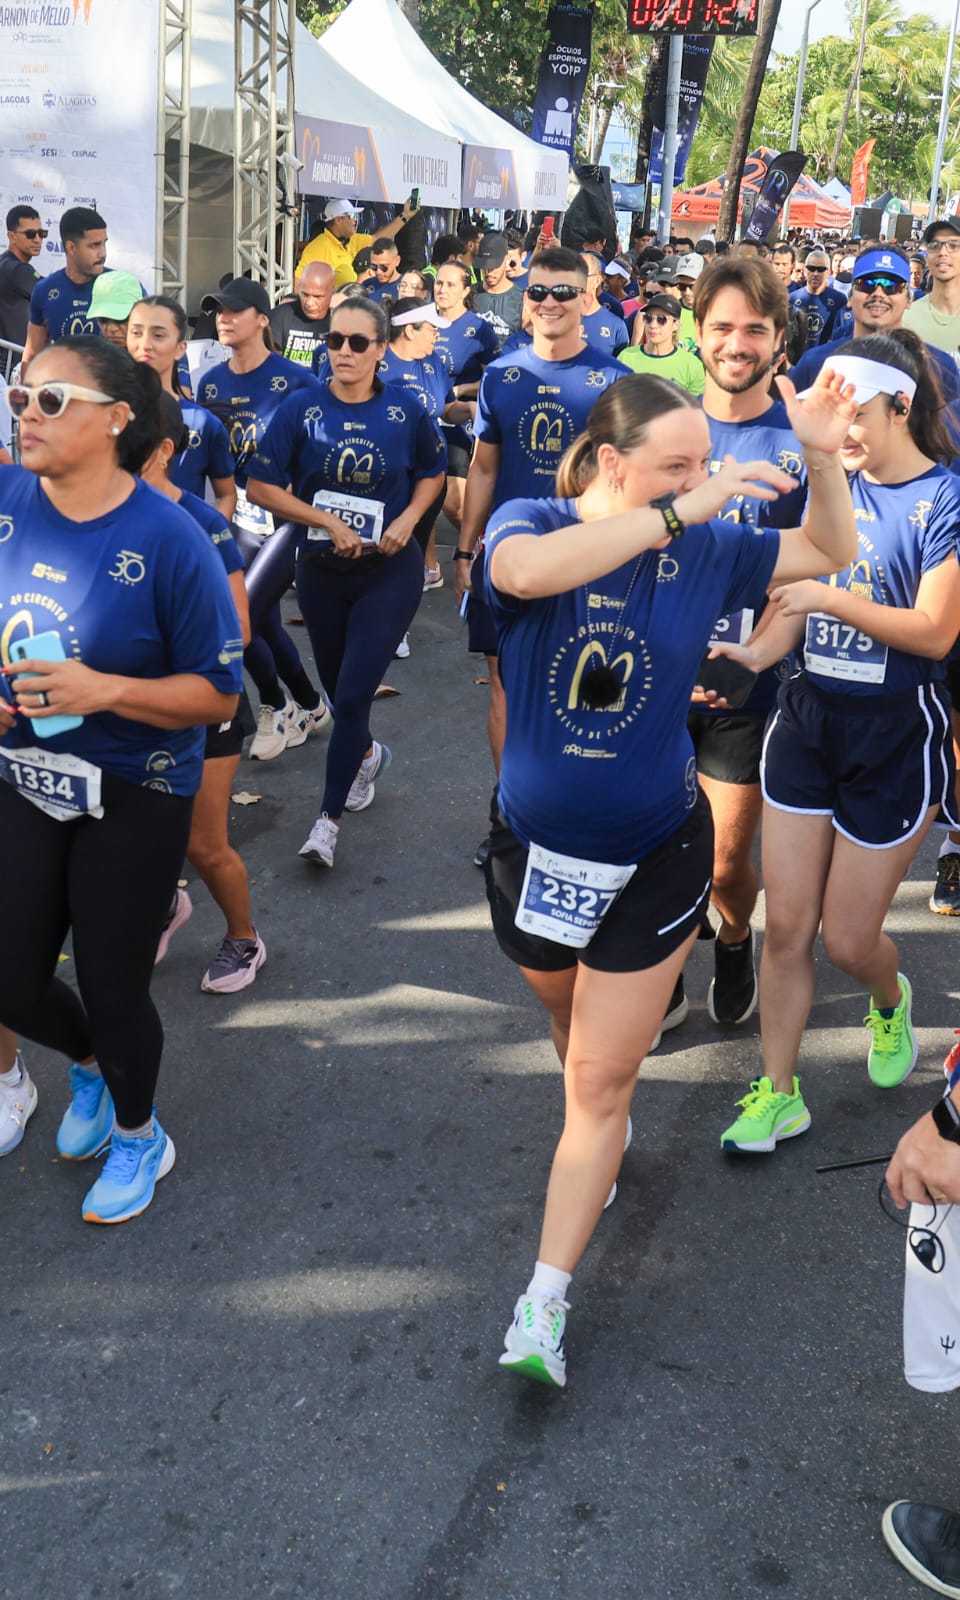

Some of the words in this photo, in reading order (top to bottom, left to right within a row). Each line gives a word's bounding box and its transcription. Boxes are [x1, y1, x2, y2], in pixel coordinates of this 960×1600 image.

[0, 6, 29, 26] ARNON
[30, 9, 39, 23] DE
[39, 6, 70, 26] MELLO
[548, 54, 587, 65] ESPORTIVOS
[679, 86, 702, 96] ORTIVOS
[680, 79, 697, 88] CULOS
[58, 95, 96, 105] ALAGOAS
[542, 136, 571, 146] BRASIL
[312, 159, 333, 183] ARNON
[337, 163, 355, 185] MELLO
[402, 153, 448, 188] CRONOMETRAGEM
[292, 336, 326, 351] DEVA
[503, 369, 520, 382] 50
[585, 371, 606, 386] 30
[269, 378, 288, 391] 30
[387, 406, 405, 422] 30
[345, 437, 374, 448] CIRCUITO
[776, 452, 801, 473] 30
[108, 552, 146, 582] 30
[656, 558, 679, 579] 0
[23, 592, 68, 622] CIRCUITO
[588, 622, 635, 640] CIRCUITO
[815, 621, 873, 652] 3175
[836, 651, 850, 659] MEL
[10, 763, 75, 800] 1334
[541, 877, 618, 918] 2327
[551, 908, 573, 922] SOFIA
